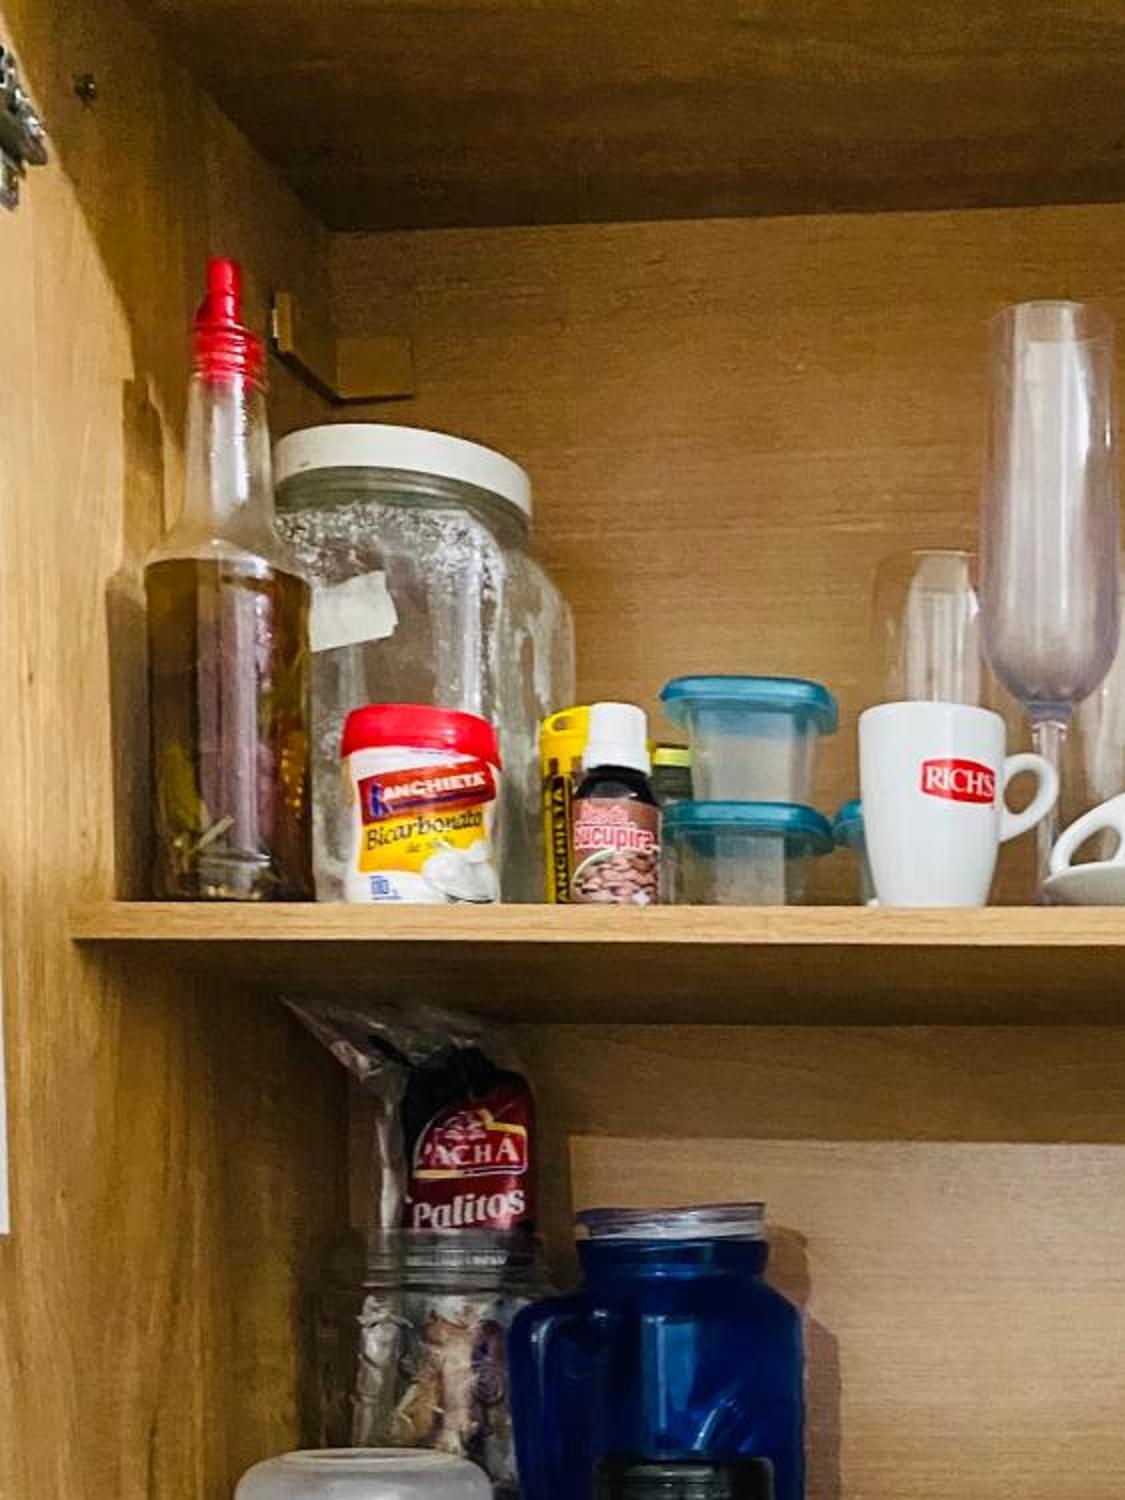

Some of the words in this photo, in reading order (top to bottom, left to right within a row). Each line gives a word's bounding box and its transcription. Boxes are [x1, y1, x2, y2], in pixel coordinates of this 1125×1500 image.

[383, 771, 486, 801] ANCHIETA
[366, 811, 482, 850] Bicarbonato
[414, 1189, 525, 1233] Palitos
